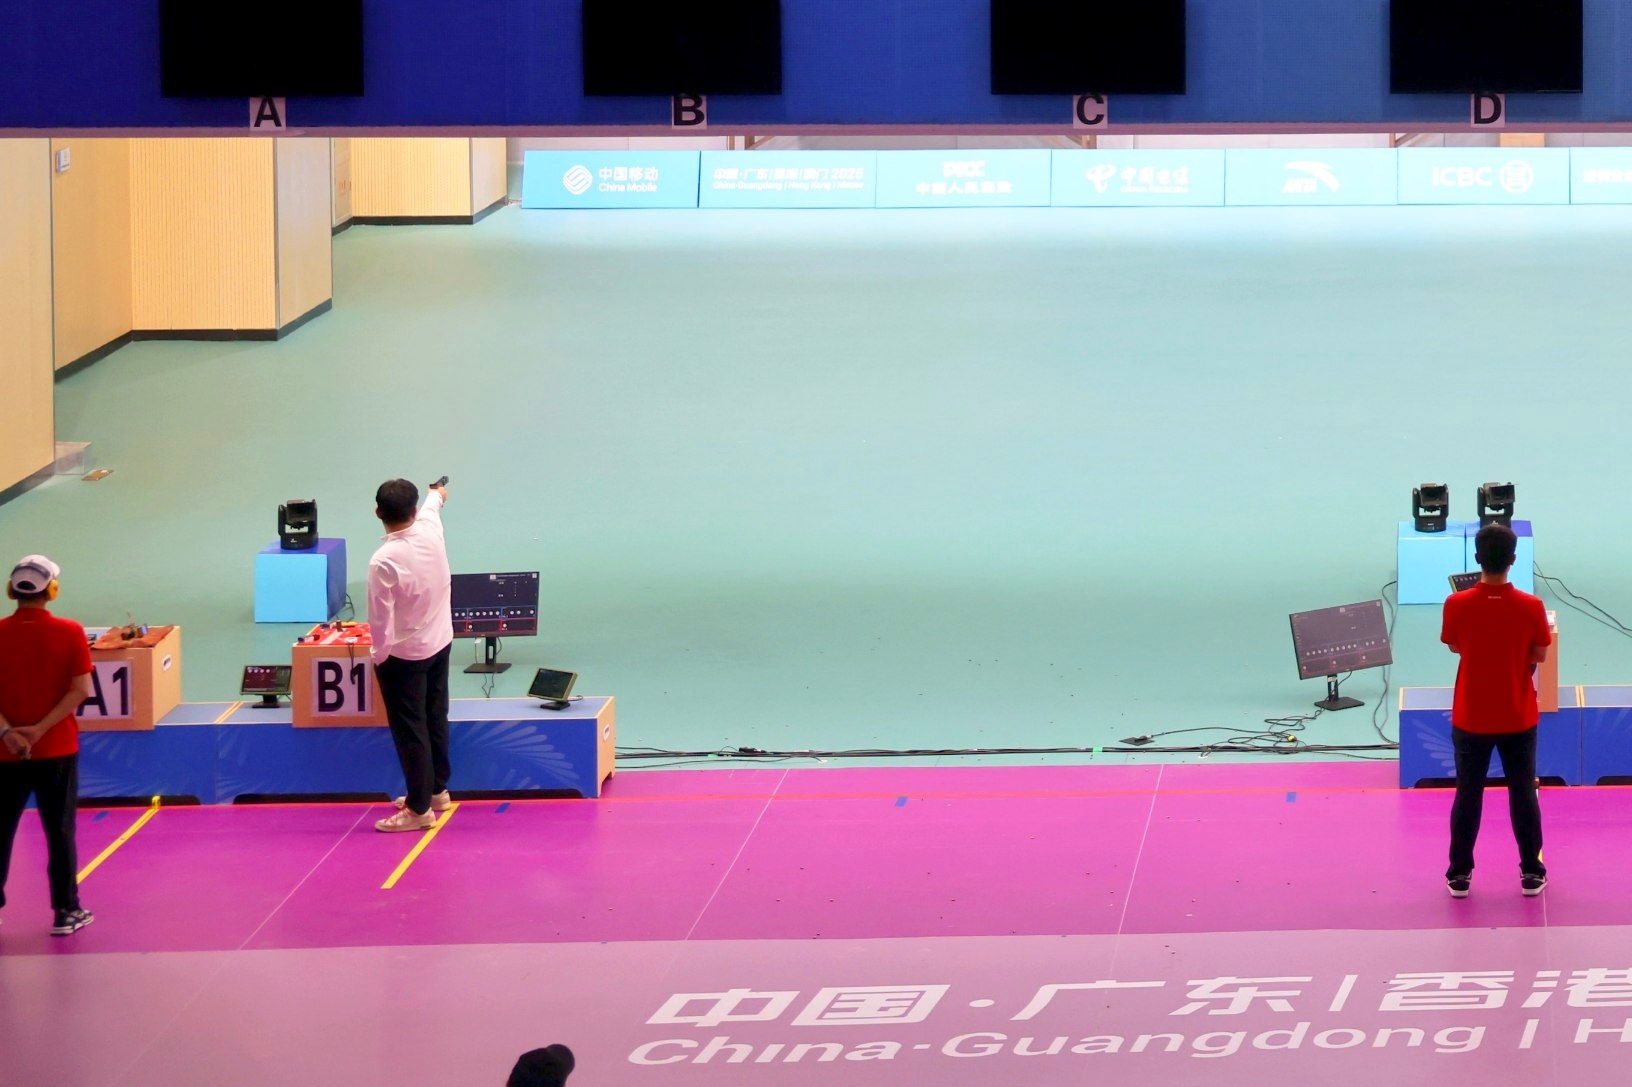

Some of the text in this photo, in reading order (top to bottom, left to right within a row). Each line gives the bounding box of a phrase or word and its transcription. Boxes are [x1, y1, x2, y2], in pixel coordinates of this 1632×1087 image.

[254, 97, 282, 128] A
[675, 95, 705, 126] B
[1077, 94, 1104, 125] C
[1475, 94, 1501, 124] D
[599, 166, 658, 180] 中国移动
[599, 181, 657, 191] China Mobile
[1432, 165, 1492, 186] ICBC
[76, 666, 128, 716] A1
[318, 661, 365, 712] B1
[627, 1021, 1486, 1065] China·Guangdong
